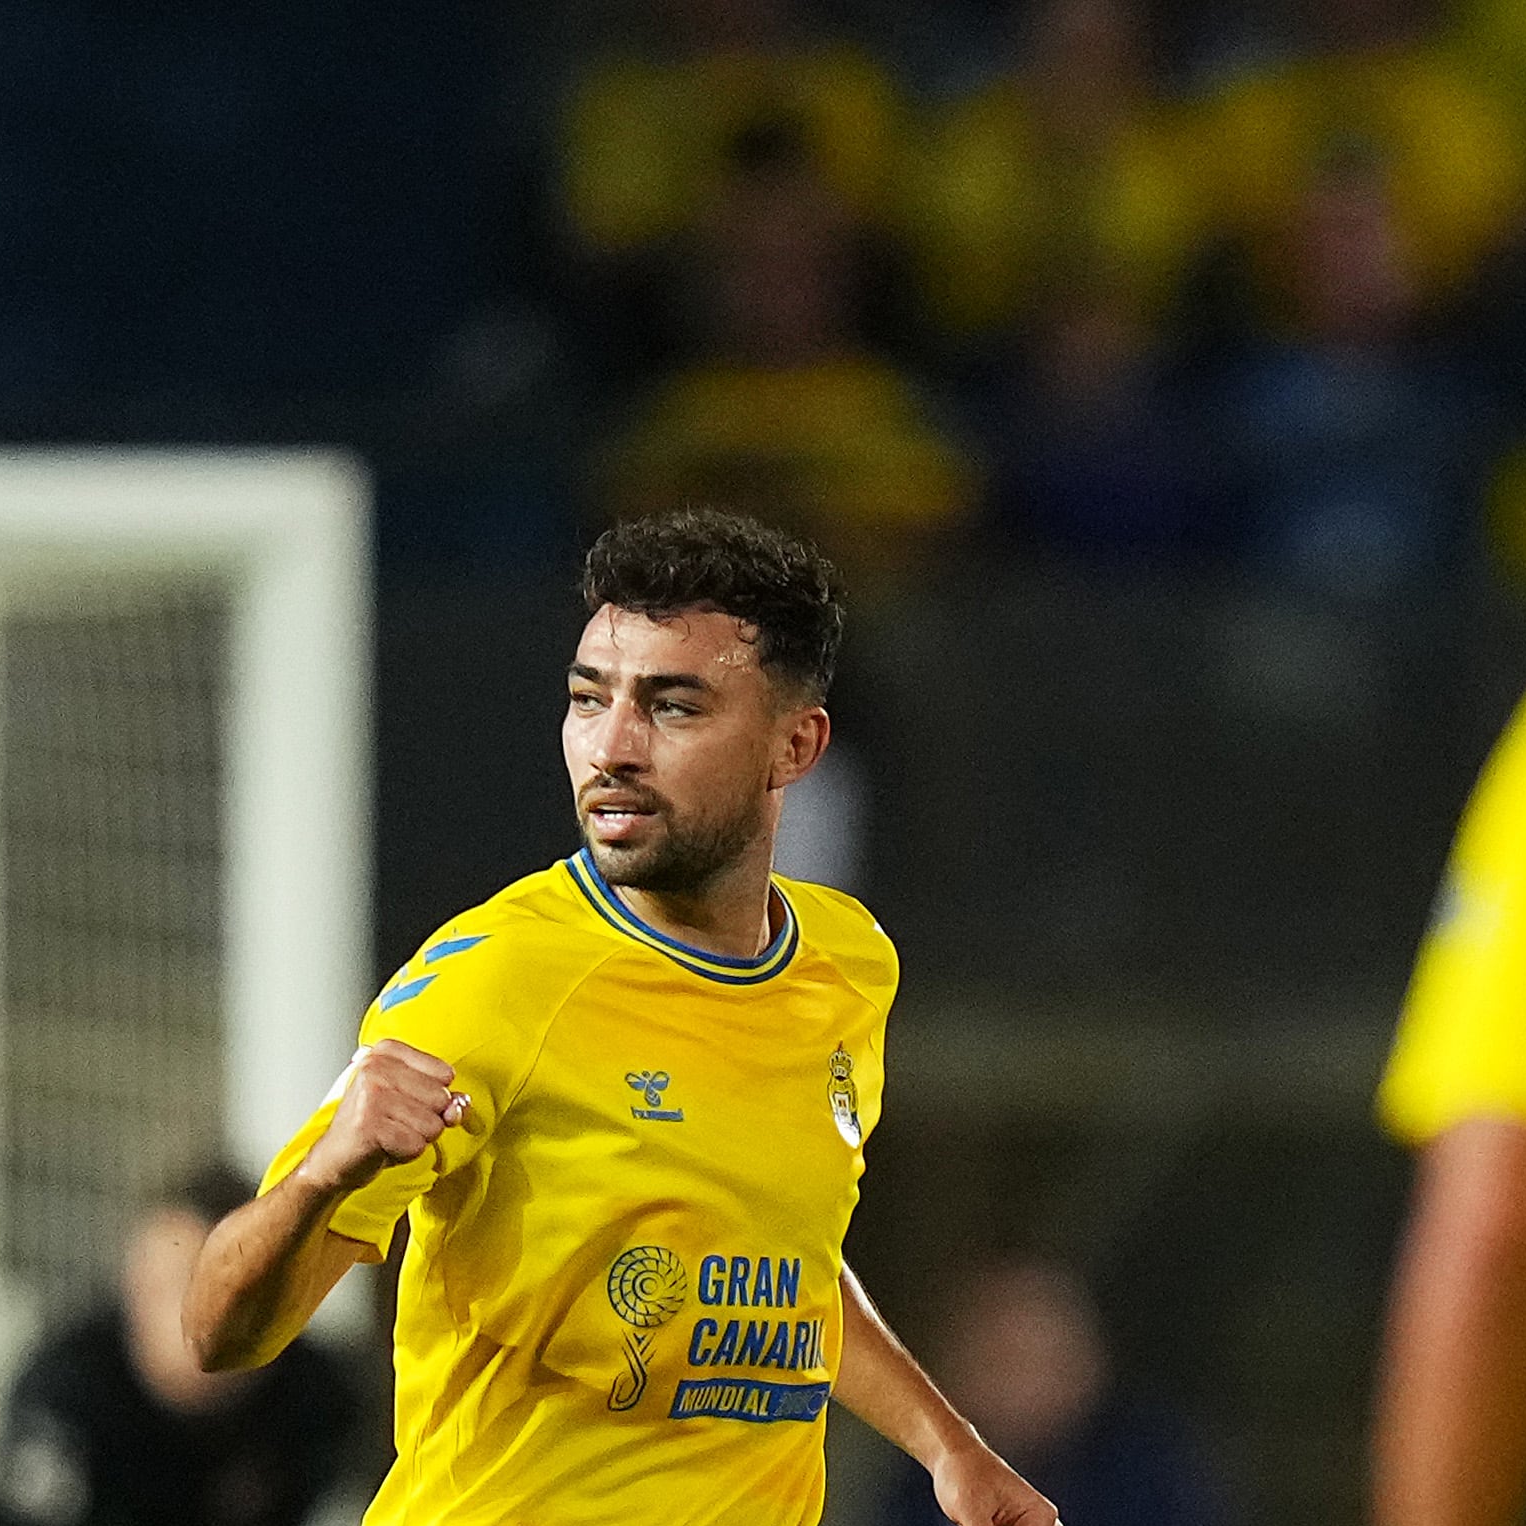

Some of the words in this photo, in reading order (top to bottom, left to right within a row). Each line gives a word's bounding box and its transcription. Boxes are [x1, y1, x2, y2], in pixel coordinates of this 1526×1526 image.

[698, 1254, 801, 1308] GRAN
[688, 1317, 826, 1371] CANARI
[678, 1386, 772, 1417] MUNDIAL
